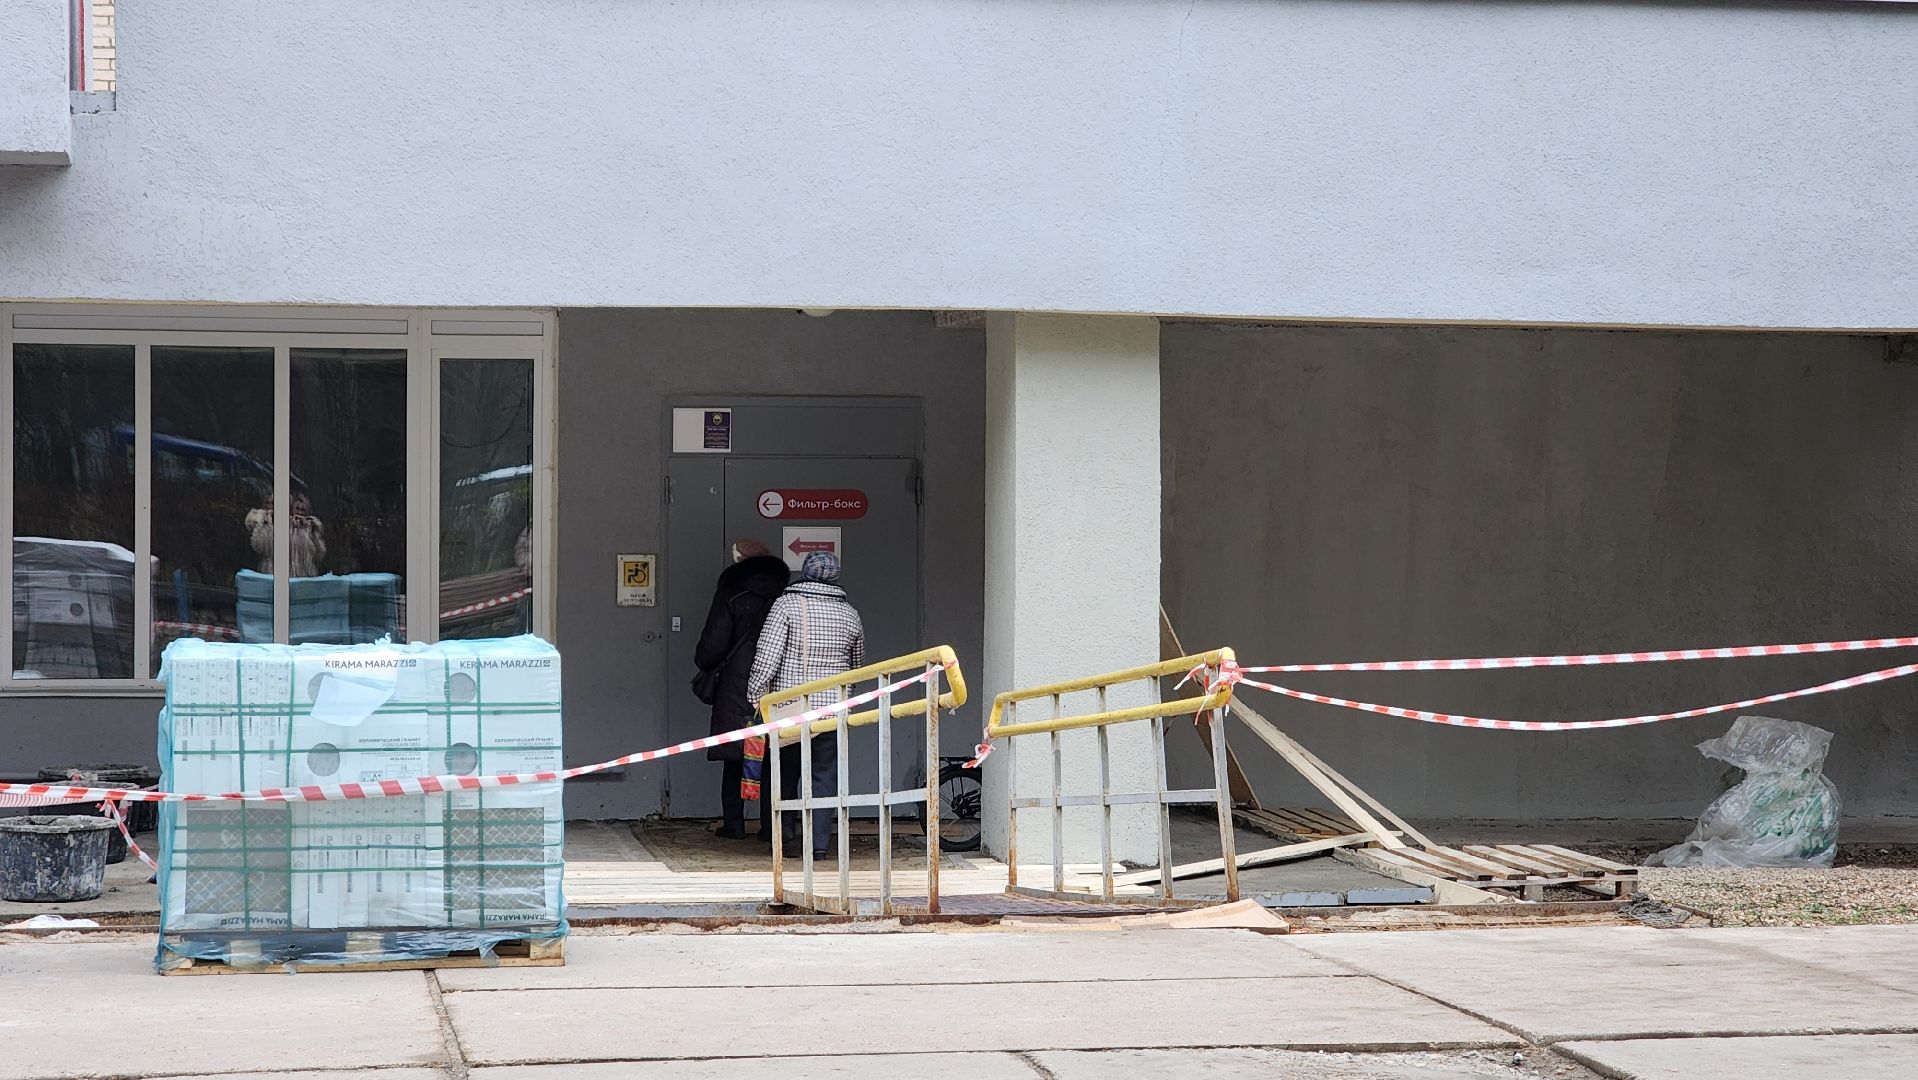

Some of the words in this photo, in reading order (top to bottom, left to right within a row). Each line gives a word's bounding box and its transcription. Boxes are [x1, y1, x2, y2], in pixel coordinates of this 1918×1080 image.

[787, 498, 861, 511] Фильтр-бокс
[365, 659, 408, 669] MARAZZI
[501, 659, 542, 669] MARAZZI
[228, 917, 263, 925] MAAZZI
